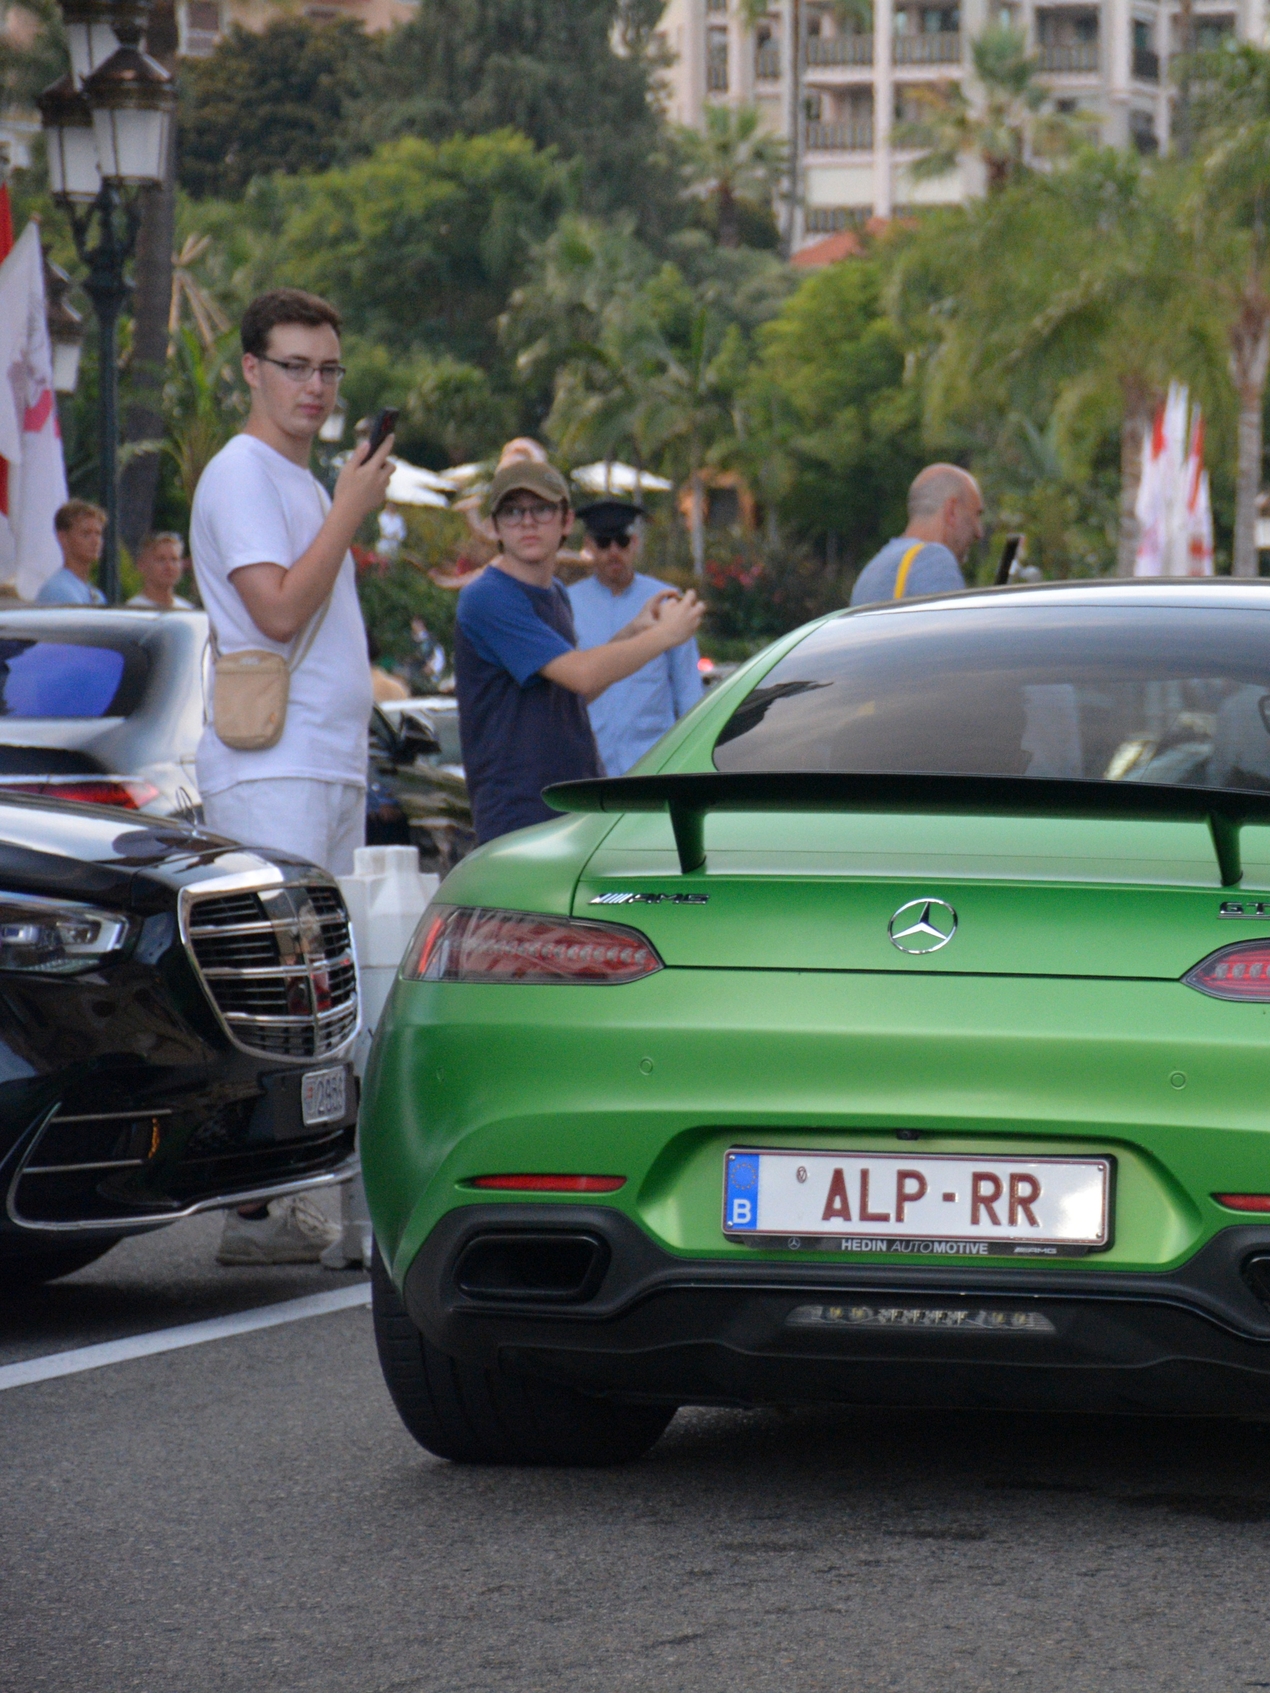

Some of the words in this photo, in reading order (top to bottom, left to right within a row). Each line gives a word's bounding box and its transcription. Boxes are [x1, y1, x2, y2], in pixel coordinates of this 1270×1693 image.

[628, 893, 709, 904] AMG
[732, 1199, 751, 1224] B
[841, 1238, 887, 1252] HEDIN
[890, 1240, 989, 1255] AUTOMOTIVE
[1028, 1246, 1058, 1255] AMG
